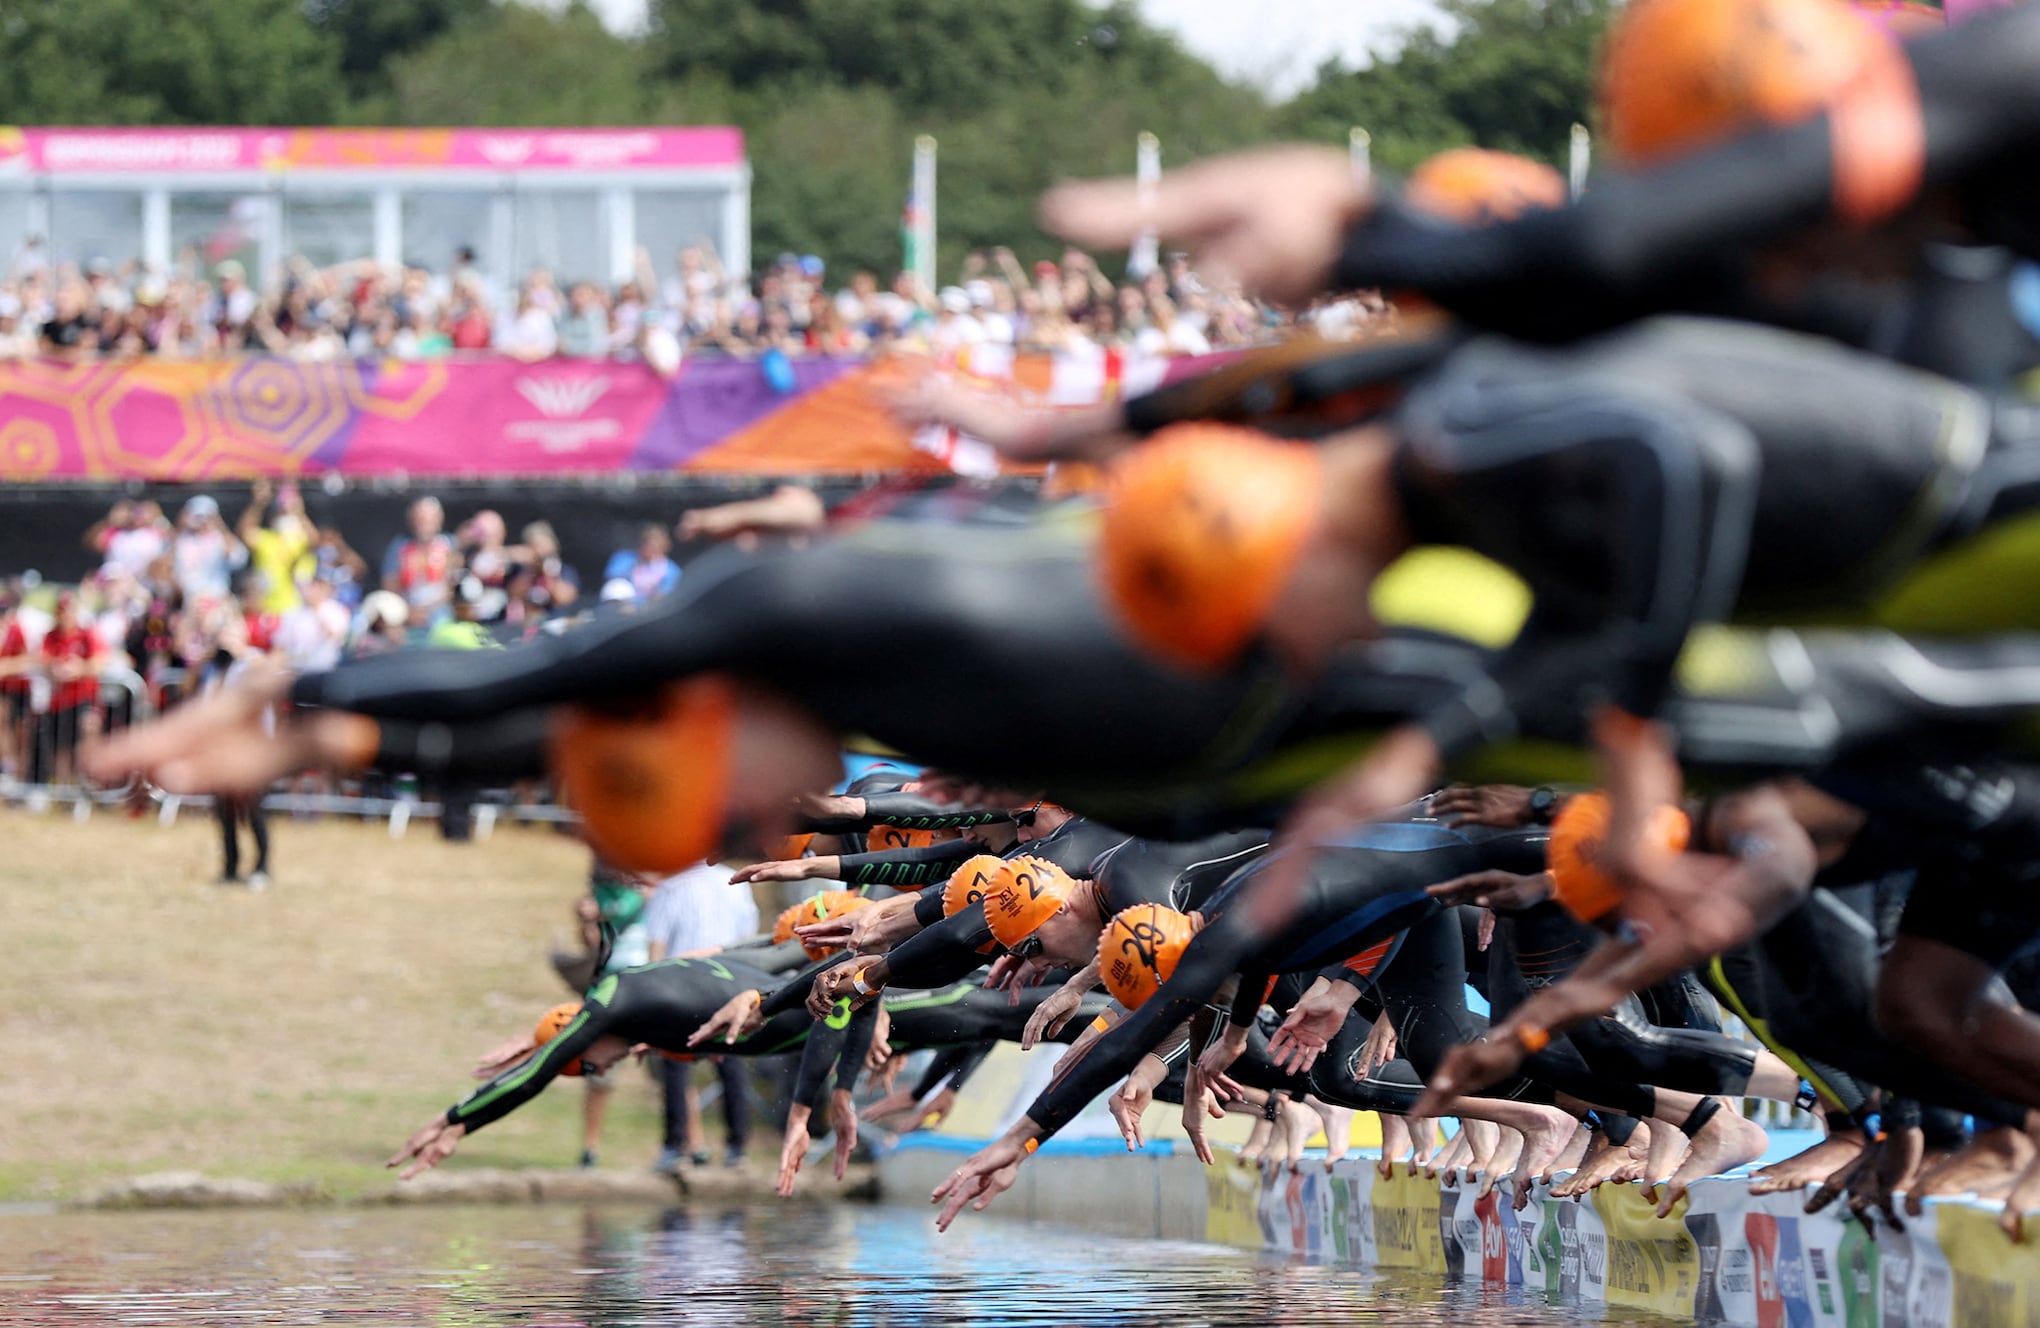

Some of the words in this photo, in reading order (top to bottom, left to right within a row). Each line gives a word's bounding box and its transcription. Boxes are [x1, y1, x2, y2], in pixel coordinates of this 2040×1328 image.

[999, 886, 1014, 906] JEY
[1016, 863, 1055, 901] 24
[1121, 922, 1165, 968] 29
[1111, 959, 1126, 980] GIB
